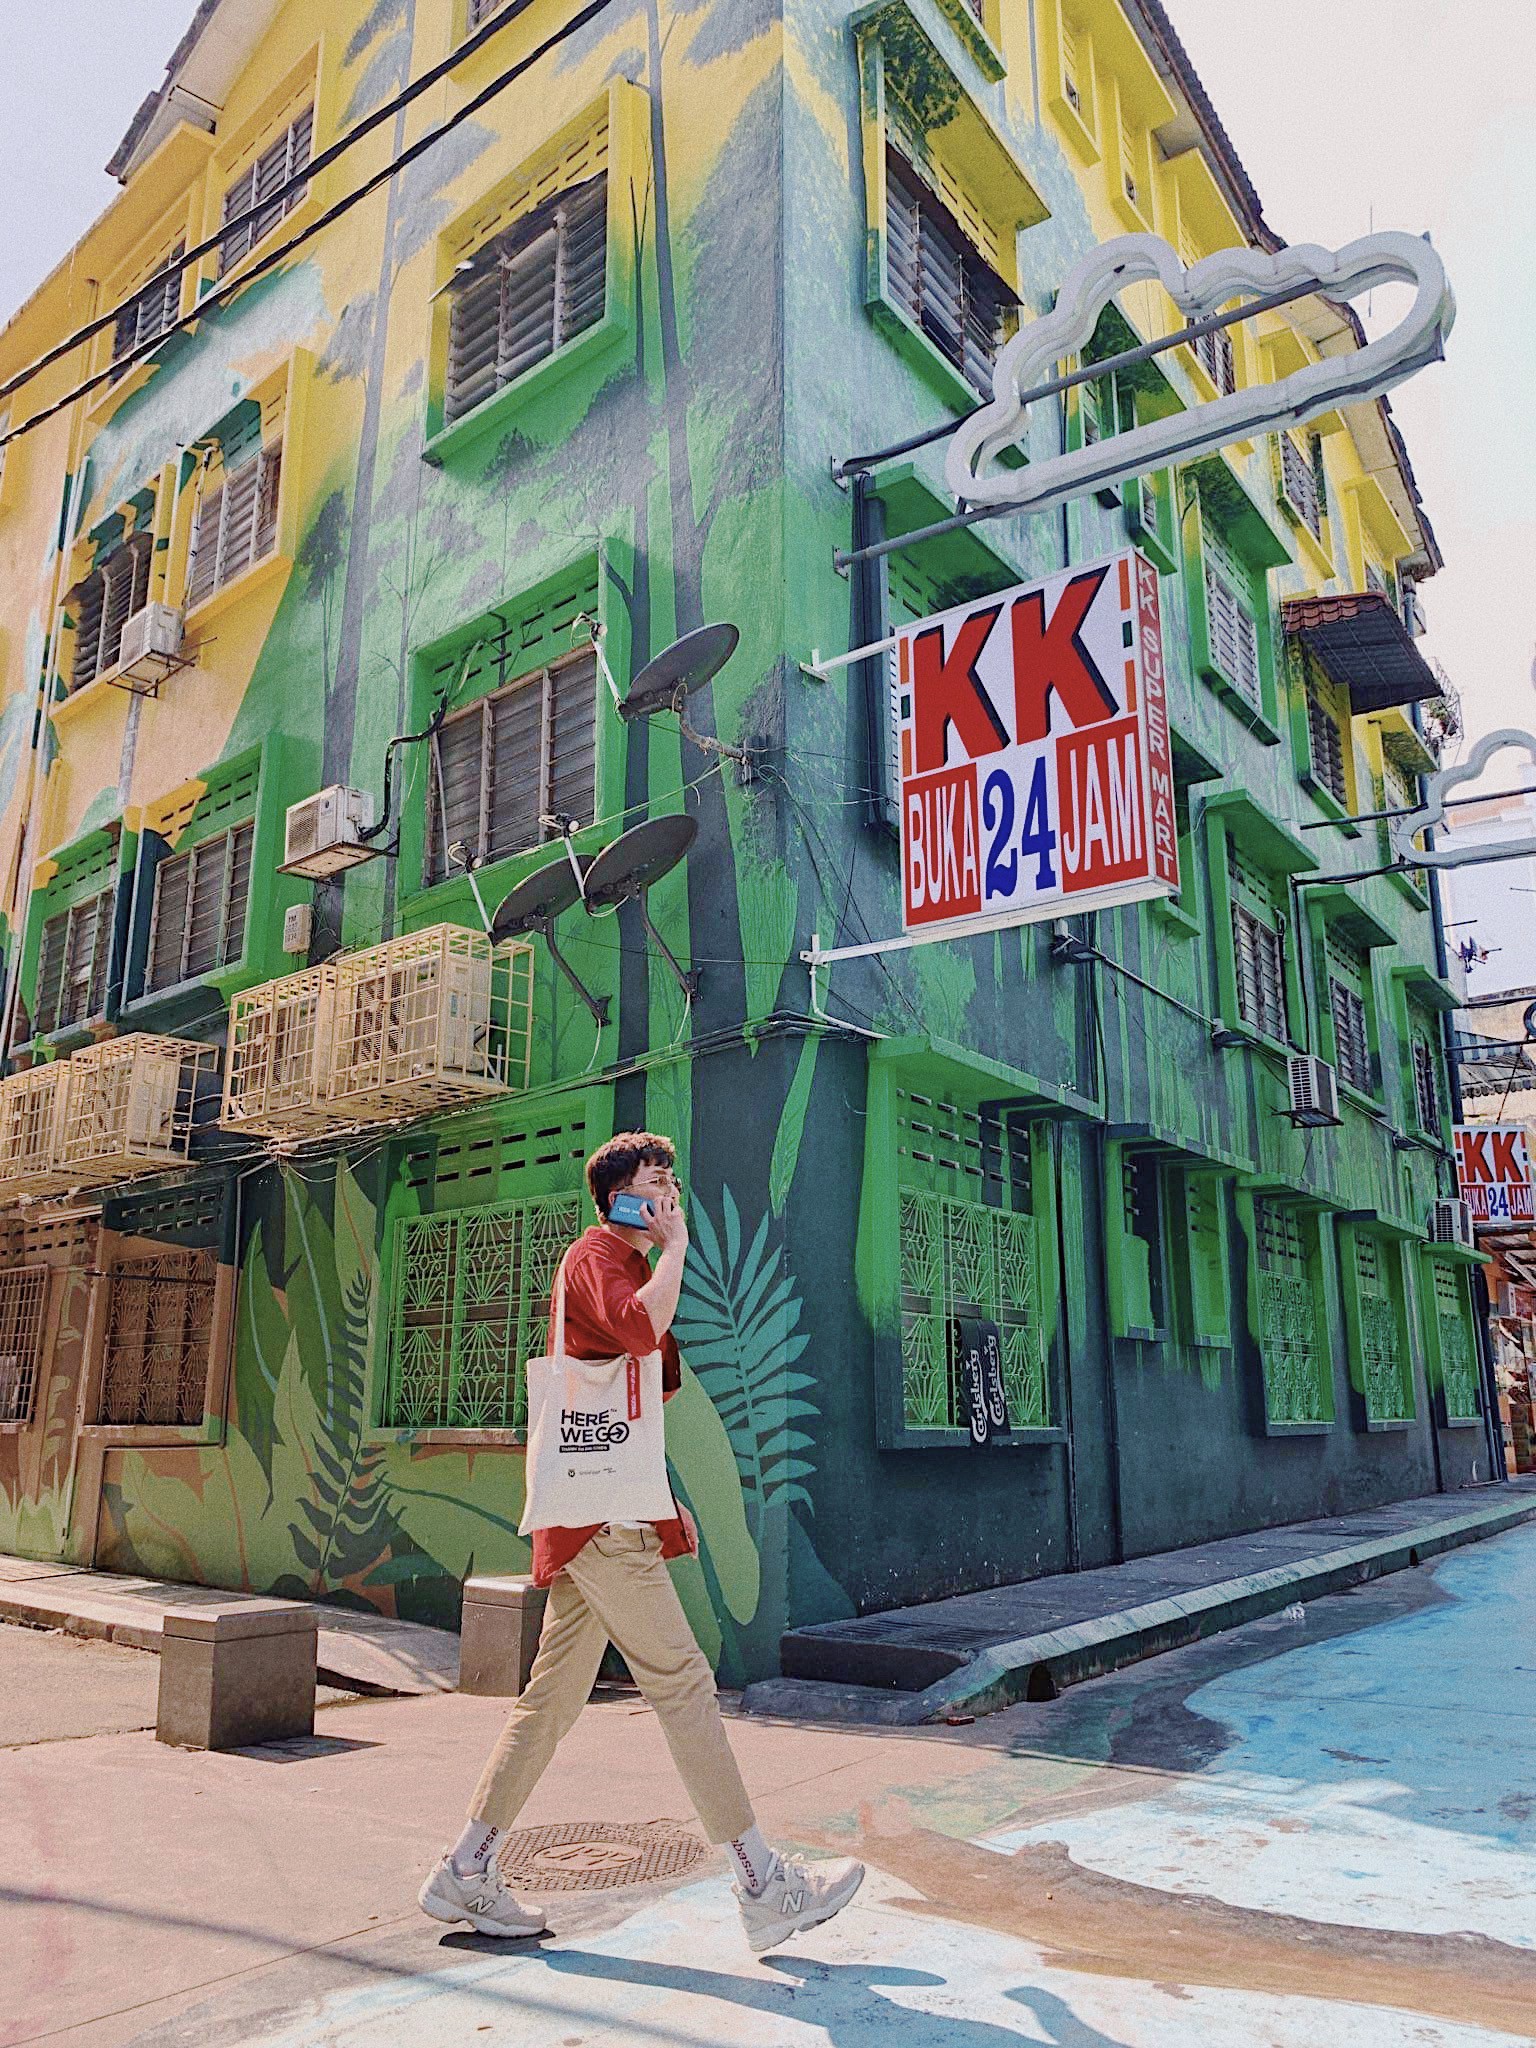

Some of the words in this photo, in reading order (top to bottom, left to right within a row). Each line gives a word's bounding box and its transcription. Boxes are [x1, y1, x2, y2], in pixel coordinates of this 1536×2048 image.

[1137, 563, 1156, 620] KK
[913, 564, 1120, 773] KK
[1142, 626, 1167, 761] SUPER
[908, 779, 979, 908] BUKA
[982, 756, 1057, 901] 24
[1062, 732, 1143, 875] JAM
[1151, 766, 1175, 877] MART
[1462, 1131, 1524, 1183] KK
[1488, 1187, 1510, 1217] 24
[1511, 1187, 1534, 1216] JAM
[561, 1409, 610, 1427] HERE
[965, 1349, 988, 1443] Carlsberg
[984, 1334, 1005, 1426] Carlsberg
